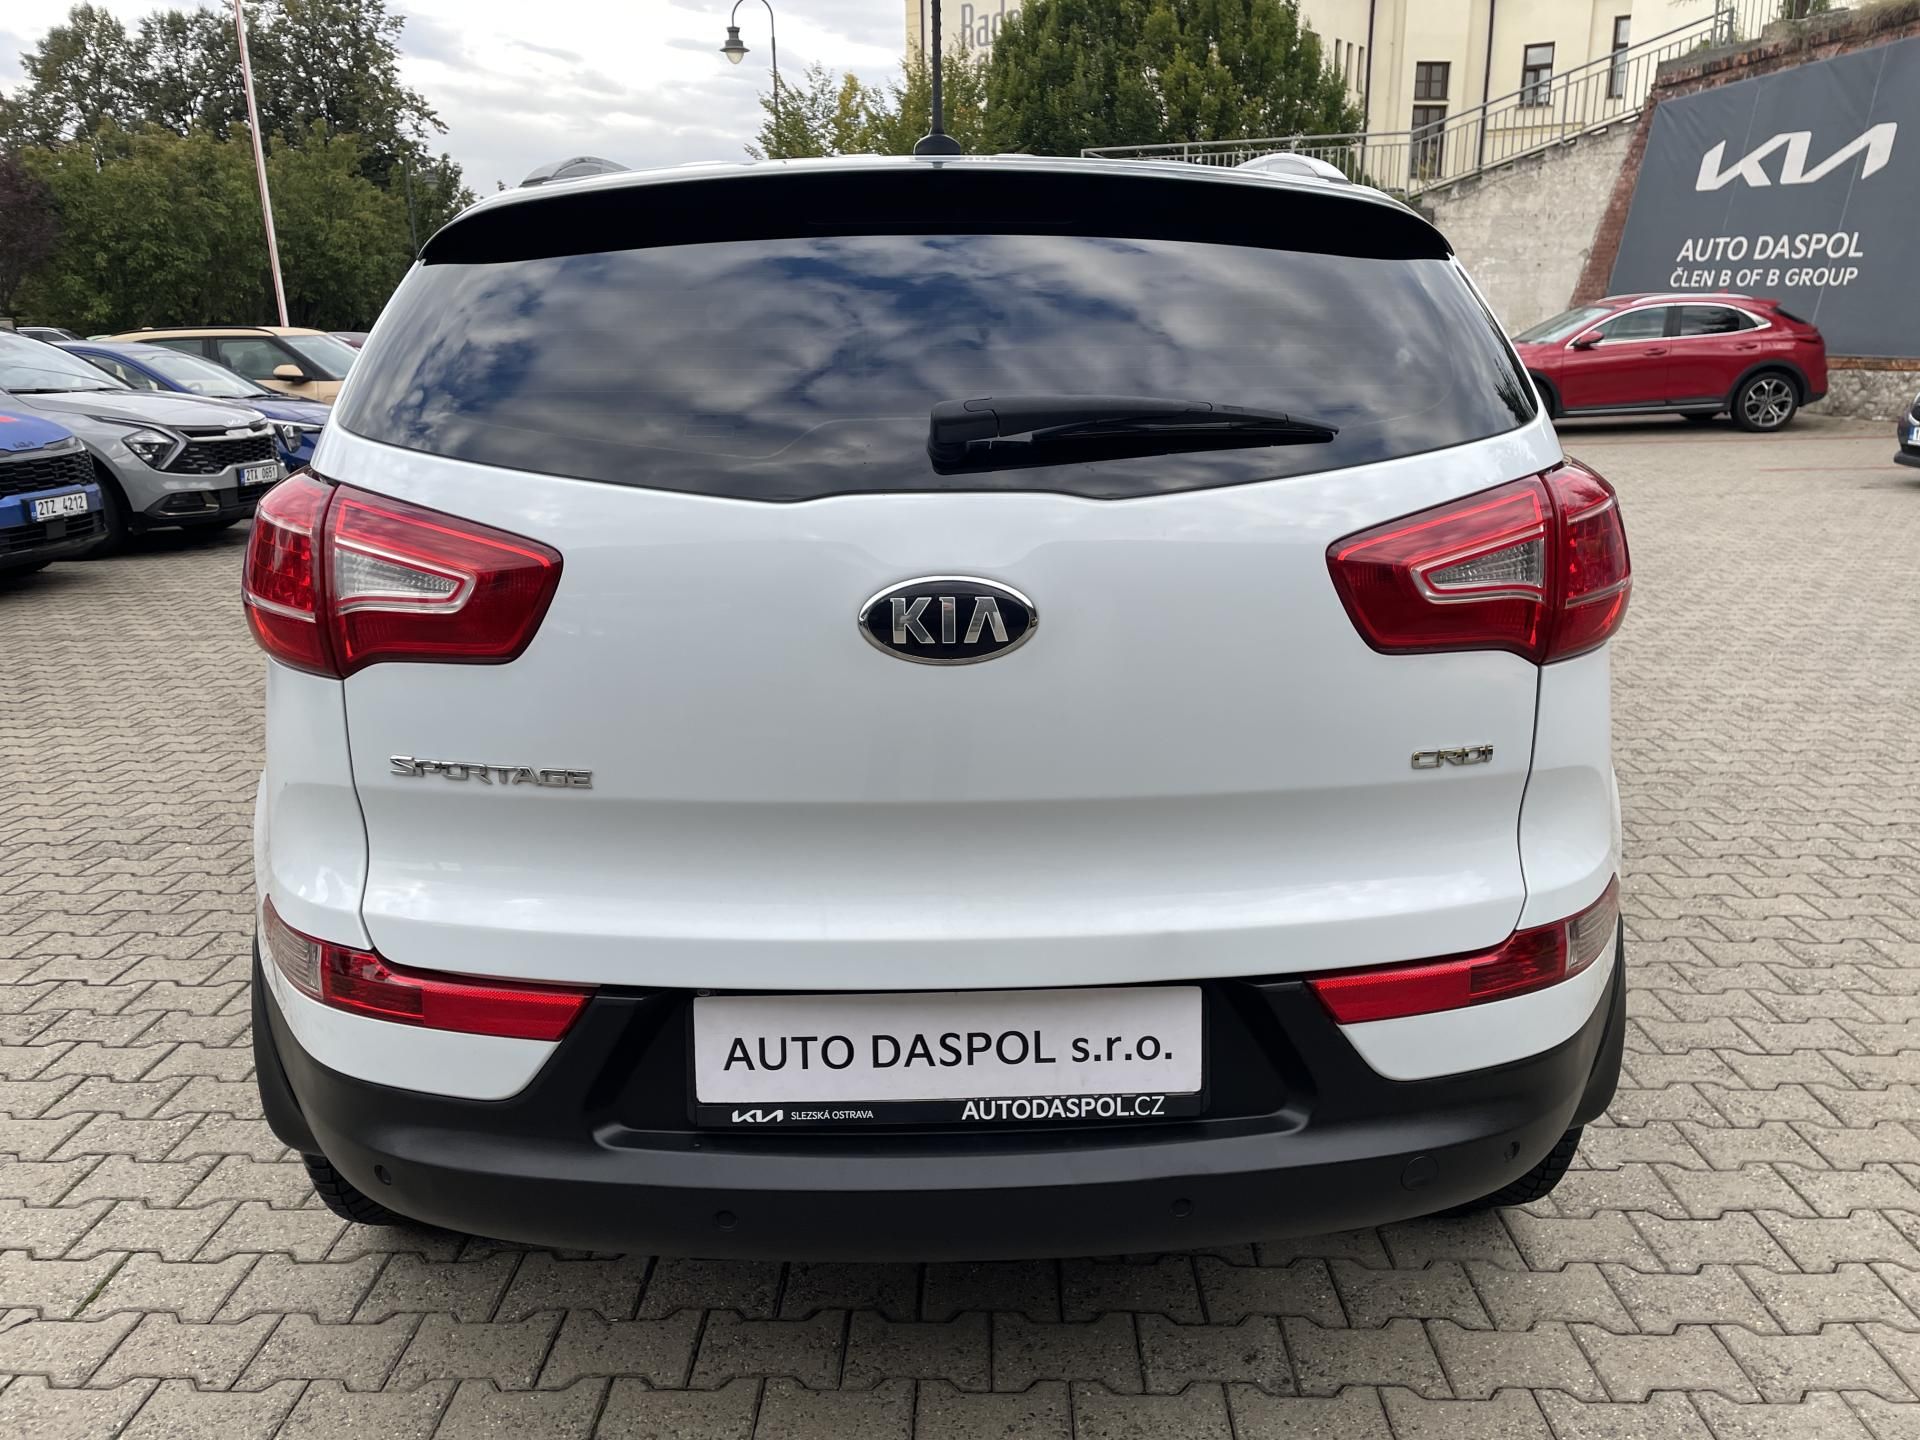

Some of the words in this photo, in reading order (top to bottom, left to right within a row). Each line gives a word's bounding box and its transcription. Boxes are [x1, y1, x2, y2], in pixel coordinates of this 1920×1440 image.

[1695, 121, 1898, 192] KIA
[1676, 236, 1748, 262] AUTO
[1753, 232, 1863, 260] DASPOL
[1670, 267, 1715, 287] ČLEN
[1718, 269, 1731, 287] B
[1736, 269, 1763, 287] OF
[1766, 269, 1780, 287] B
[1785, 267, 1858, 287] GROUP
[38, 500, 57, 516] 2TZ
[63, 495, 84, 511] 4212
[890, 596, 1009, 644] KIA
[390, 754, 592, 789] SPORTAGE
[723, 1035, 854, 1071] AUTO
[872, 1030, 1056, 1068] DASPOL
[1072, 1035, 1173, 1063] s.r.o.
[731, 1109, 784, 1123] KIA
[791, 1110, 830, 1120] SLEZSKÁ
[832, 1110, 874, 1120] OSTRAVA
[961, 1095, 1165, 1120] AUTODASPOL.CZ
